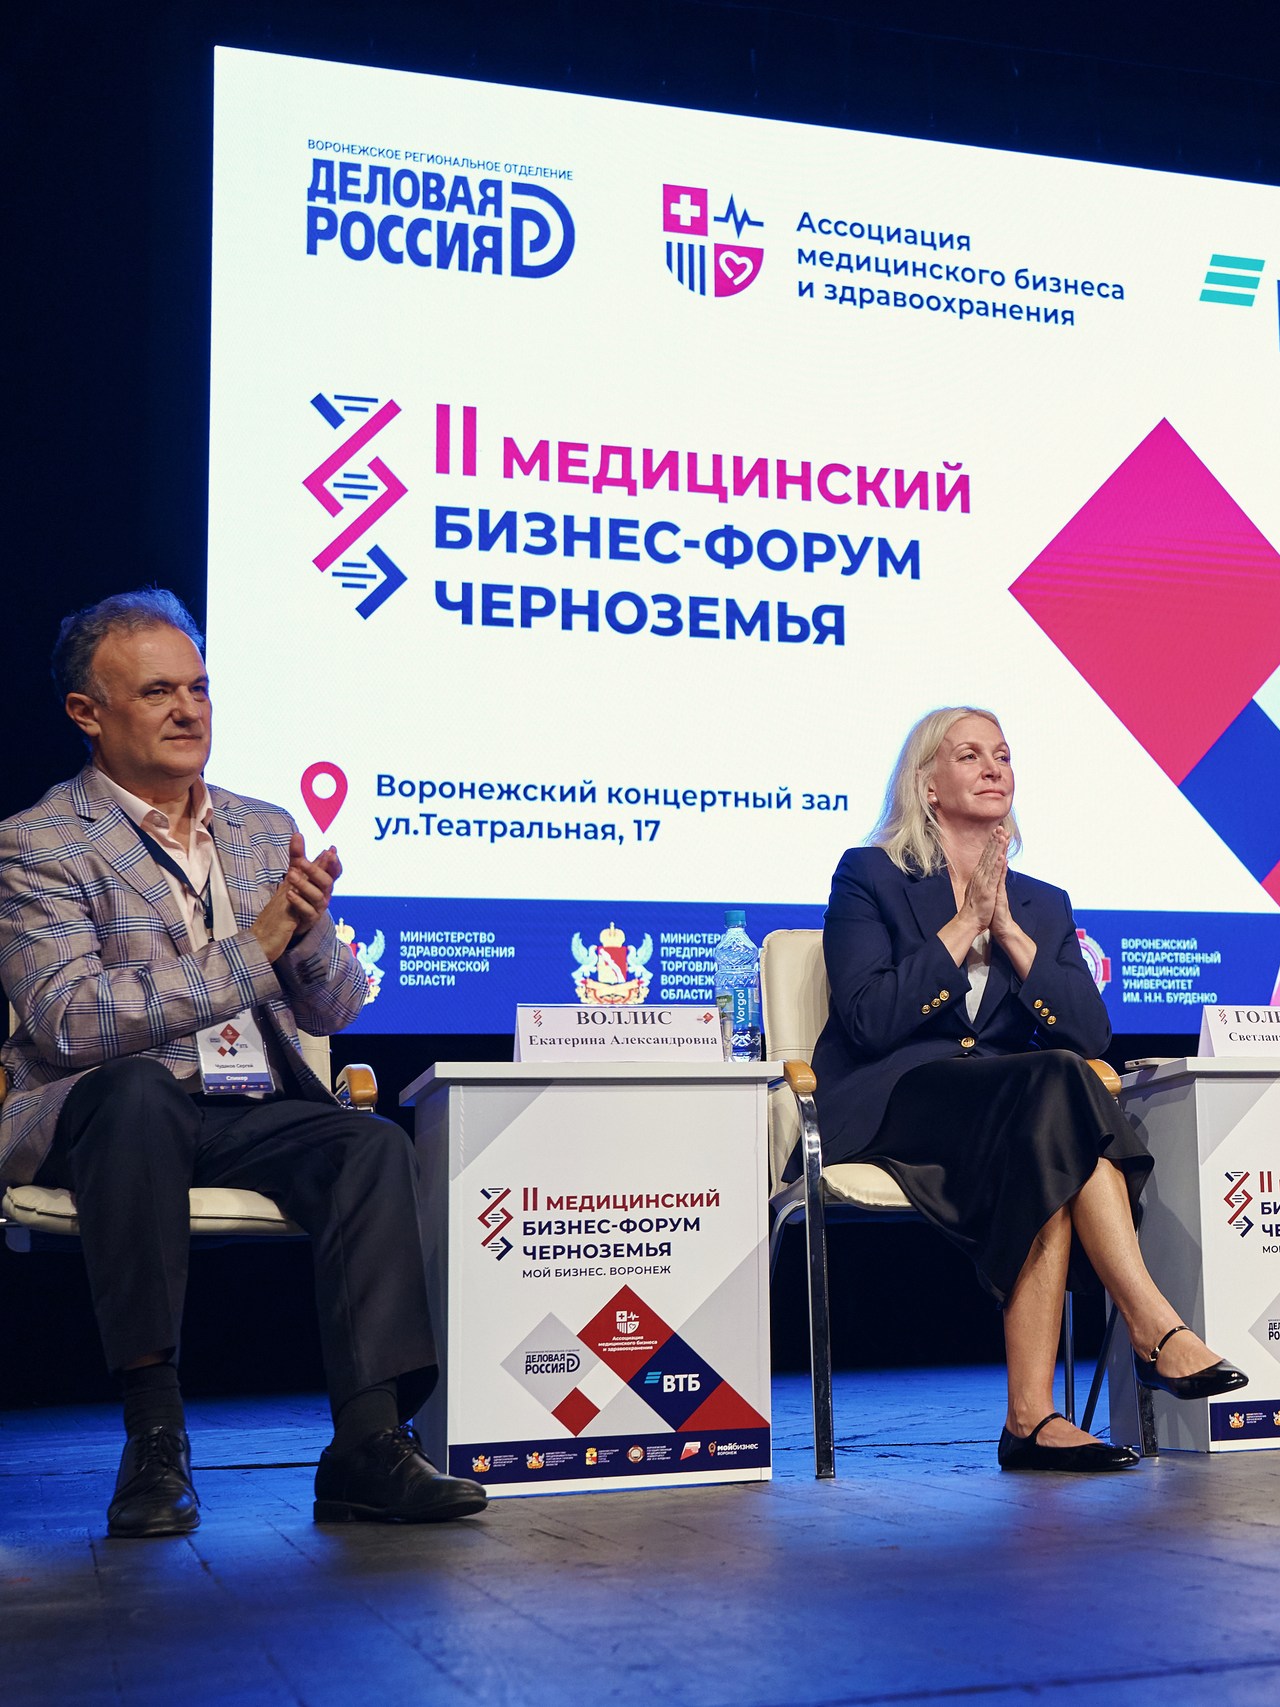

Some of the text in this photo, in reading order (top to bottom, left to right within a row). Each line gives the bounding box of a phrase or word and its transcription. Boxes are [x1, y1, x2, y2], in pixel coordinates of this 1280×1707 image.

[308, 139, 573, 181] ВОРОНЕЖСКОЕ РЕГИОНАЛЬНОЕ ОТДЕЛЕНИЕ
[307, 158, 502, 218] ДЕЛОВАЯ
[796, 211, 971, 252] Ассоциация
[307, 205, 502, 275] РОССИЯ
[797, 248, 1125, 302] медицинского бизнеса
[797, 280, 1075, 327] и здравоохранения
[435, 403, 971, 514] II МЕДИЦИНСКИЙ
[435, 505, 921, 580] БИЗНЕС-ФОРУМ
[434, 580, 845, 646] ЧЕРНОЗЕМЬЯ
[375, 773, 849, 812] Воронежский концертный зал
[374, 813, 661, 846] ул.Театральная, 17
[400, 931, 495, 944] МИНИСТЕРСТВО
[660, 933, 726, 944] МИНИСТЕР
[1121, 938, 1197, 950] ВОРОНЕЖСКИЙ
[400, 945, 515, 958] ЗДРАВООХРАНЕНИЯ
[1121, 951, 1221, 964] ГОСУДАРСТВЕННЫЙ
[400, 959, 489, 972] ВОРОНЕЖСКОЙ
[660, 961, 718, 972] ТОРГОВЛИ
[1122, 964, 1200, 978] МЕДИЦИНСКИЙ
[400, 974, 455, 986] ОБЛАСТИ
[660, 974, 715, 986] ВОРОНЕЖ
[1123, 979, 1193, 990] УНИВЕРСИТЕТ
[660, 989, 713, 999] ОБЛАСТИ
[1123, 992, 1217, 1005] ИМ. Н.Н. БУРДЕНКО
[736, 989, 745, 1023] Vorgol
[576, 1010, 672, 1025] ВОЛЛИС
[529, 1034, 717, 1047] Екатерина Александровна
[1259, 1171, 1272, 1193] II
[523, 1187, 720, 1213] II МЕДИЦИНСКИЙ
[523, 1217, 700, 1236] БИЗНЕС-ФОРУМ
[523, 1242, 671, 1260] ЧЕРНОЗЕМЬЯ
[522, 1265, 671, 1278] МОЙ БИЗНЕС. ВОРОНЕЖ
[525, 1354, 565, 1364] ДЕЛОВАЯ
[525, 1363, 565, 1374] РОССИЯ
[663, 1373, 700, 1392] ВТБ
